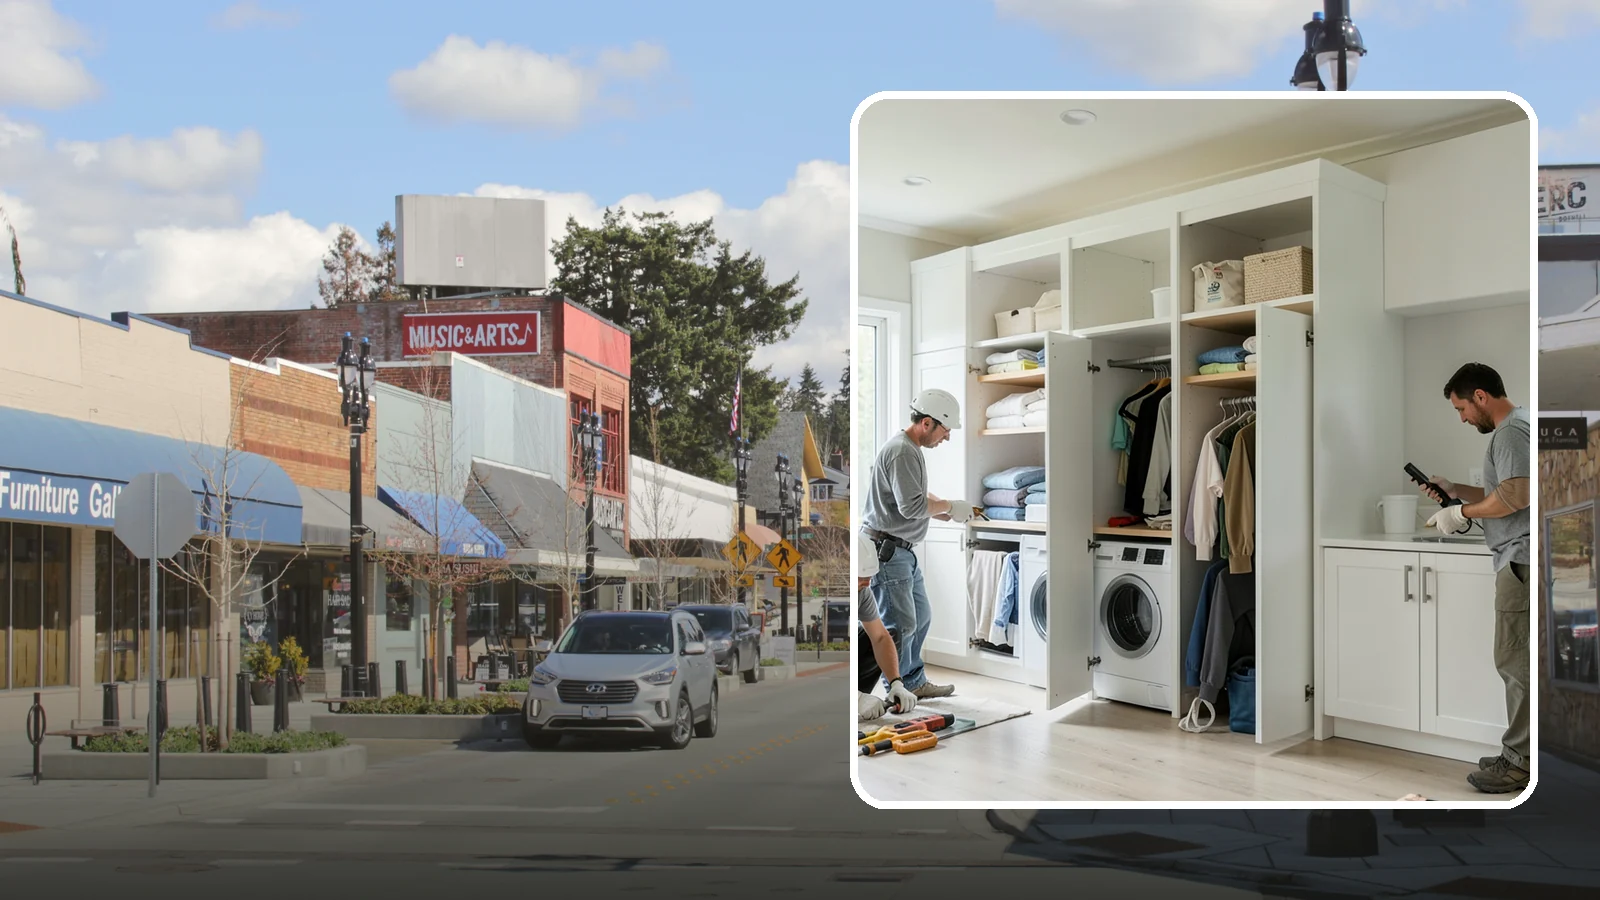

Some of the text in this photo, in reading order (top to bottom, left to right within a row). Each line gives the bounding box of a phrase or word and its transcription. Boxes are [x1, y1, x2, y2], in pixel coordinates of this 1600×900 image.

[409, 323, 519, 348] MUSIC&ARTS
[1540, 428, 1577, 436] UGA
[0, 471, 79, 515] Furniture
